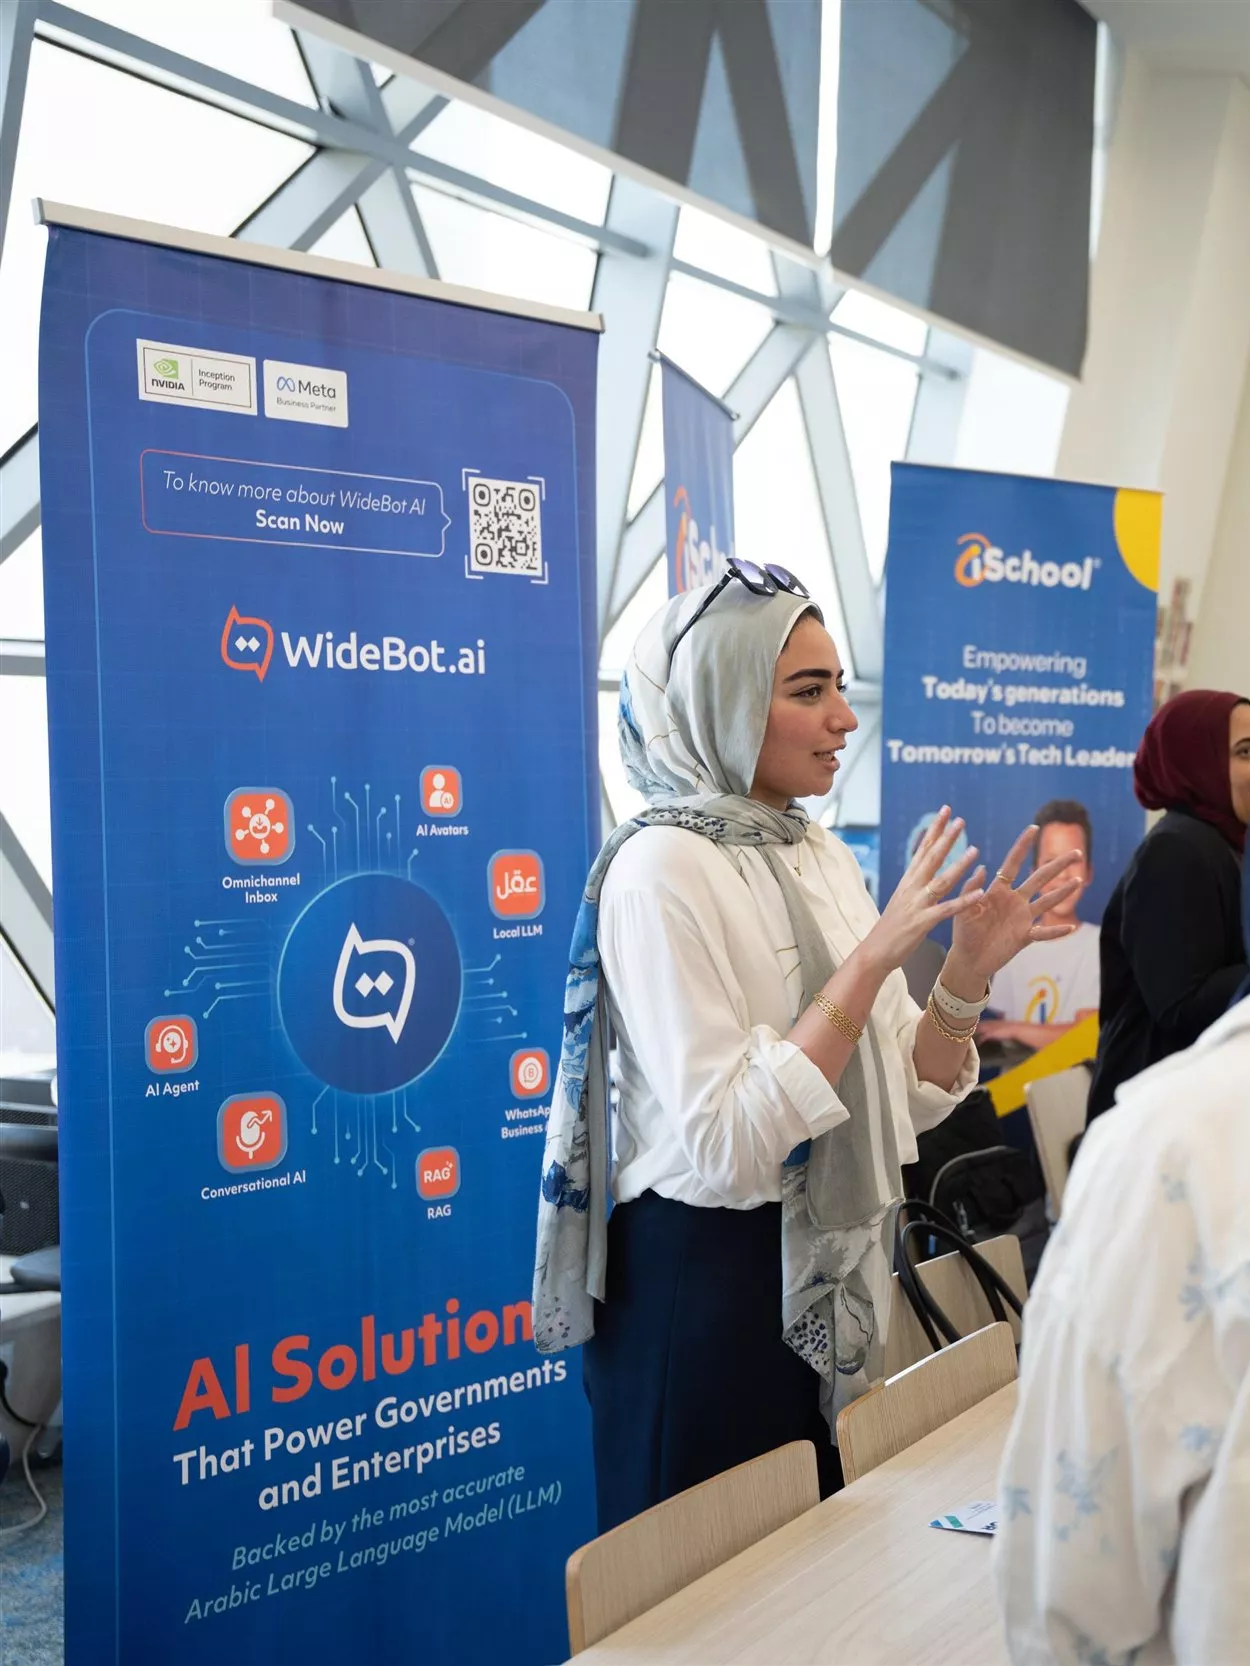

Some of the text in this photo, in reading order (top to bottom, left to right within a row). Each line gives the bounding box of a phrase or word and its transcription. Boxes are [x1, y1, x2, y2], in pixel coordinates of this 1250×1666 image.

[199, 369, 235, 382] Inception
[199, 379, 233, 392] Program
[298, 380, 336, 399] Meta
[276, 397, 336, 412] Business Partner
[163, 470, 426, 516] To know more about WideBot AI
[256, 509, 345, 534] Scan Now
[281, 632, 486, 675] WideBot.ai
[962, 645, 1087, 680] Empowering
[921, 676, 1125, 707] Today's generations
[970, 711, 1074, 737] To become
[887, 739, 1136, 768] Tomorrow's Tech Leader
[416, 824, 469, 837] AI Avatars
[222, 873, 301, 890] Omnichannel
[496, 869, 537, 900] عقل
[245, 890, 278, 904] Inbox
[493, 925, 543, 939] Local LLM
[145, 1079, 200, 1097] AI Agent
[505, 1104, 551, 1121] WhatsAp
[501, 1123, 543, 1139] Business
[200, 1170, 306, 1200] Conversational AI
[423, 1168, 451, 1183] RAG
[427, 1204, 452, 1219] RAG
[173, 1297, 534, 1432] AI Solution
[173, 1358, 567, 1486] That Power Governments
[258, 1421, 501, 1511] and Enterprises
[231, 1465, 526, 1571] Backed by the most accurate
[184, 1480, 563, 1624] Arabic Large Language Model (LLM)
